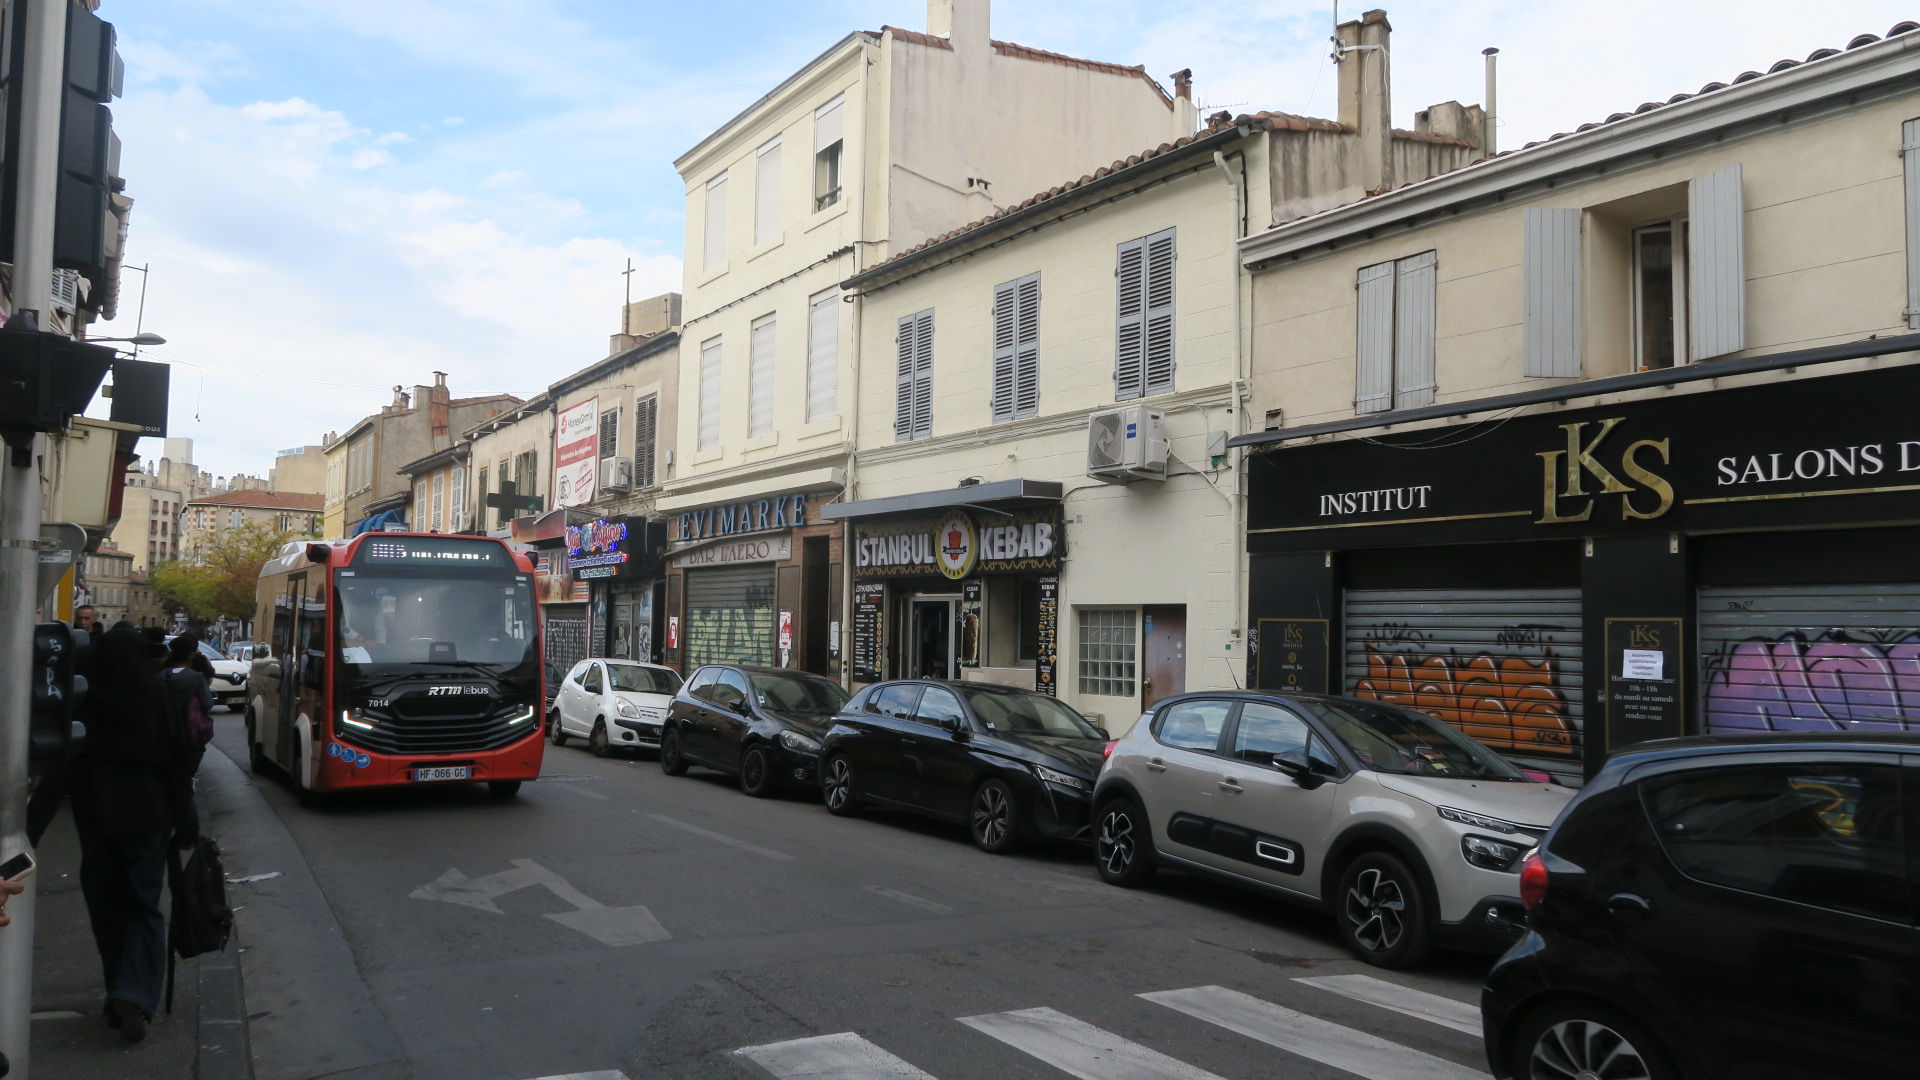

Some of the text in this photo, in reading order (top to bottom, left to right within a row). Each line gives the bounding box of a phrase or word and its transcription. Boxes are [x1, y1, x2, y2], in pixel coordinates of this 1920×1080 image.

[1535, 417, 1675, 524] LKS
[1717, 444, 1884, 486] SALONS
[1319, 485, 1431, 516] INSTITUT
[681, 494, 805, 540] EVIMARKE
[980, 523, 1053, 560] KEBAB
[689, 547, 715, 564] BAR
[1630, 624, 1660, 648] LKS
[428, 685, 489, 696] RTM lebus
[1629, 684, 1640, 692] 10h
[368, 699, 389, 707] 7014
[1625, 712, 1662, 720] rendez-vous
[420, 767, 465, 779] HF-066-GC
